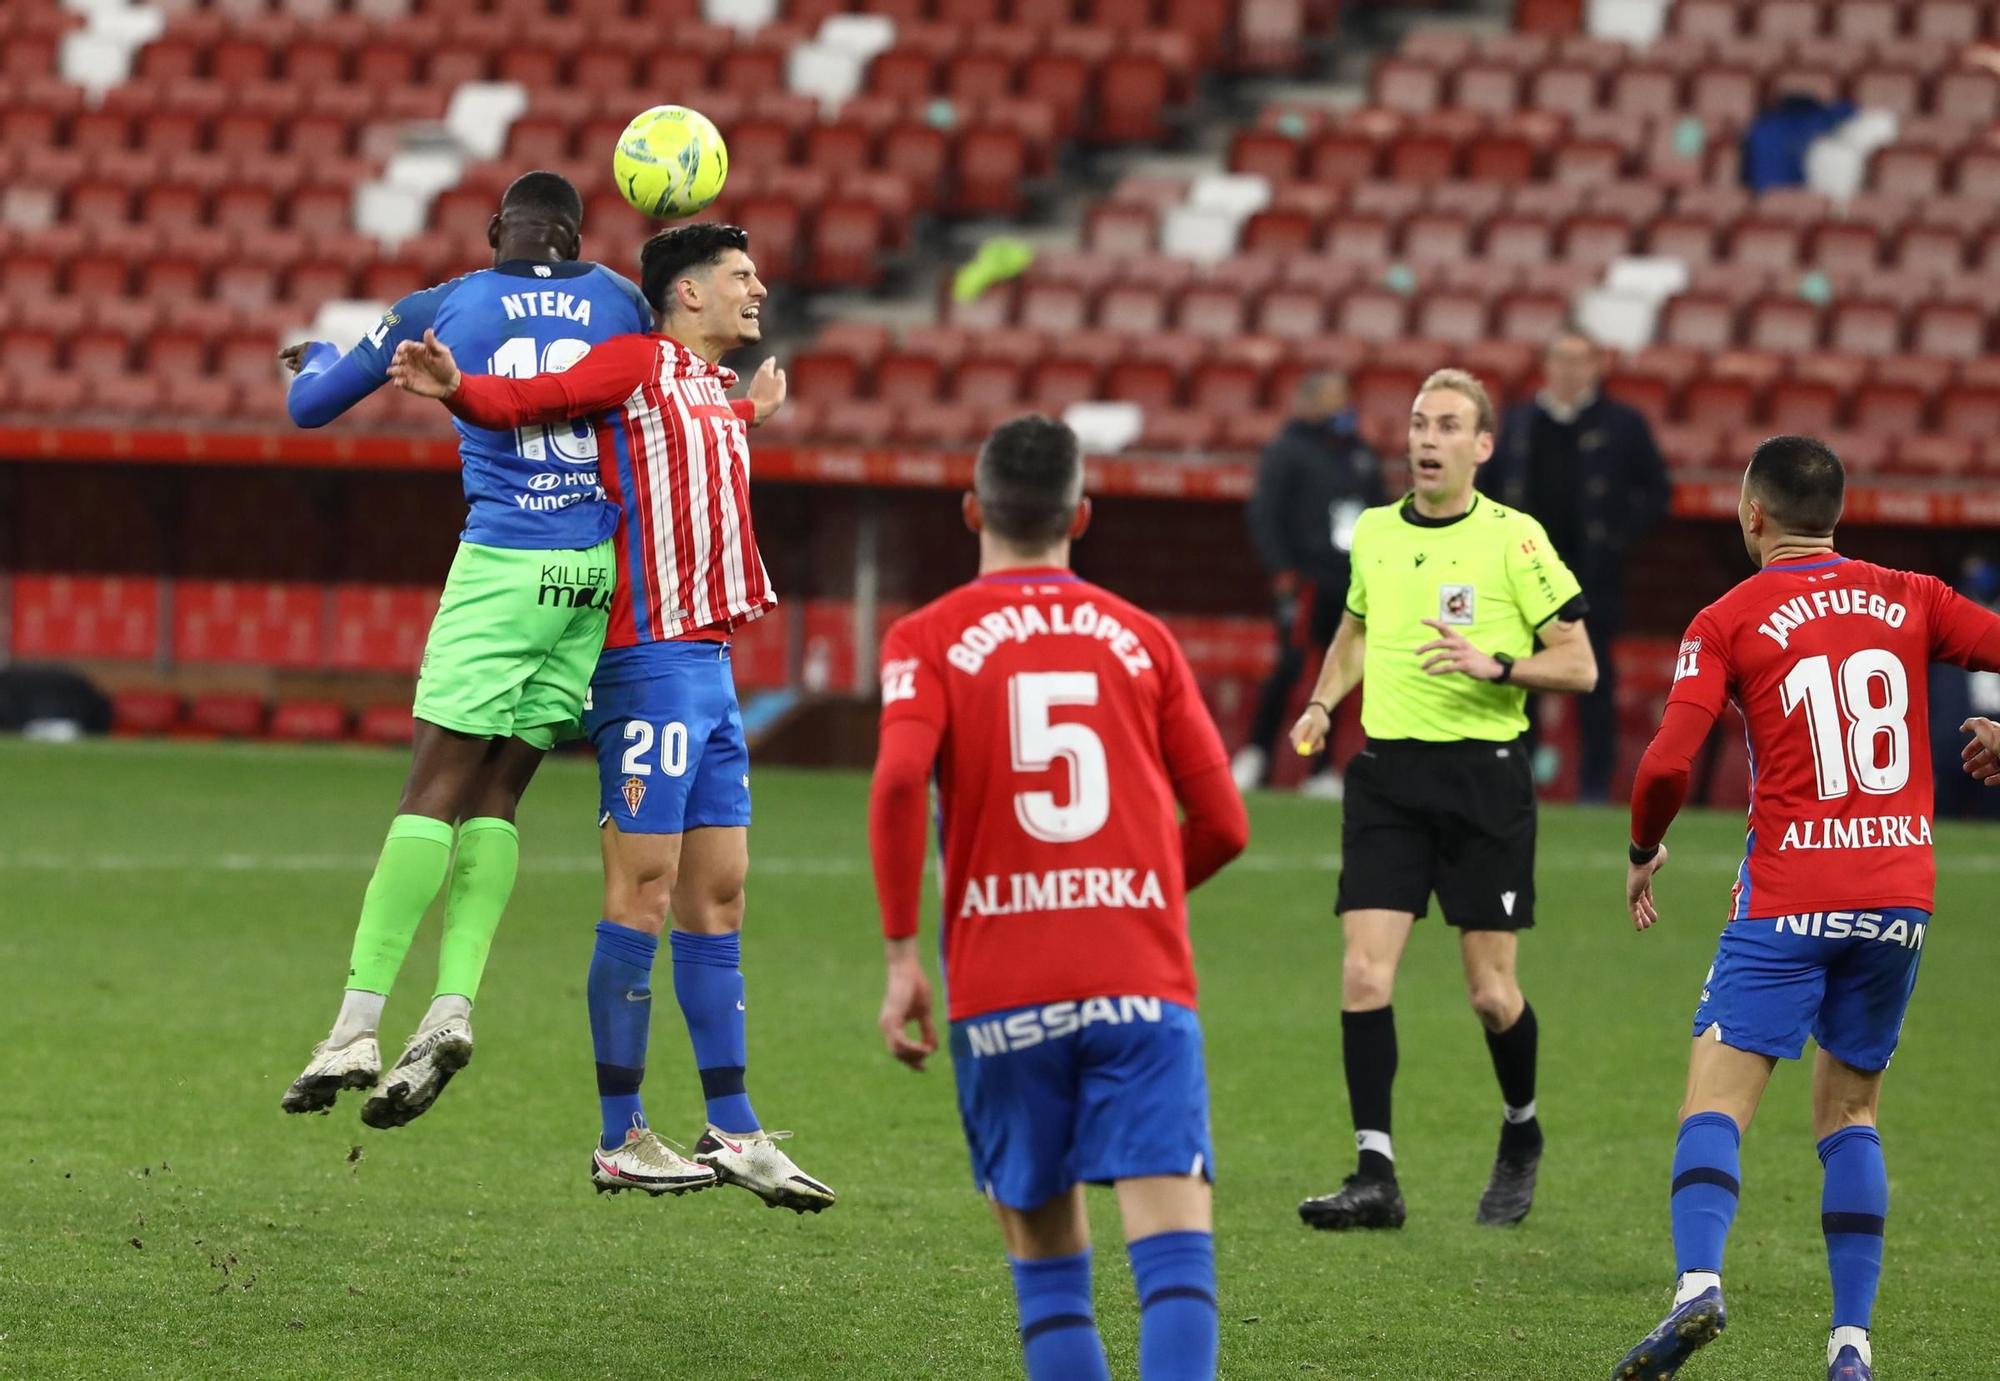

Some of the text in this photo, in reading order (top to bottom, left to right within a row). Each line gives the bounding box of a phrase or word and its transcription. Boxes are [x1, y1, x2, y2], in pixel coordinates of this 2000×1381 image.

[501, 291, 591, 327] NTEKA
[514, 491, 592, 511] Yuncar
[946, 601, 1153, 678] BORJA LÓPEZ
[1757, 588, 1907, 650] JAVI FUEGO
[621, 720, 688, 777] 20
[1778, 648, 1910, 800] 18
[1008, 671, 1111, 843] 5
[1779, 815, 1933, 851] ALIMERKA
[960, 866, 1167, 918] ALIMERKA
[1775, 911, 1926, 951] NISSAN
[966, 995, 1162, 1058] NISSAN
